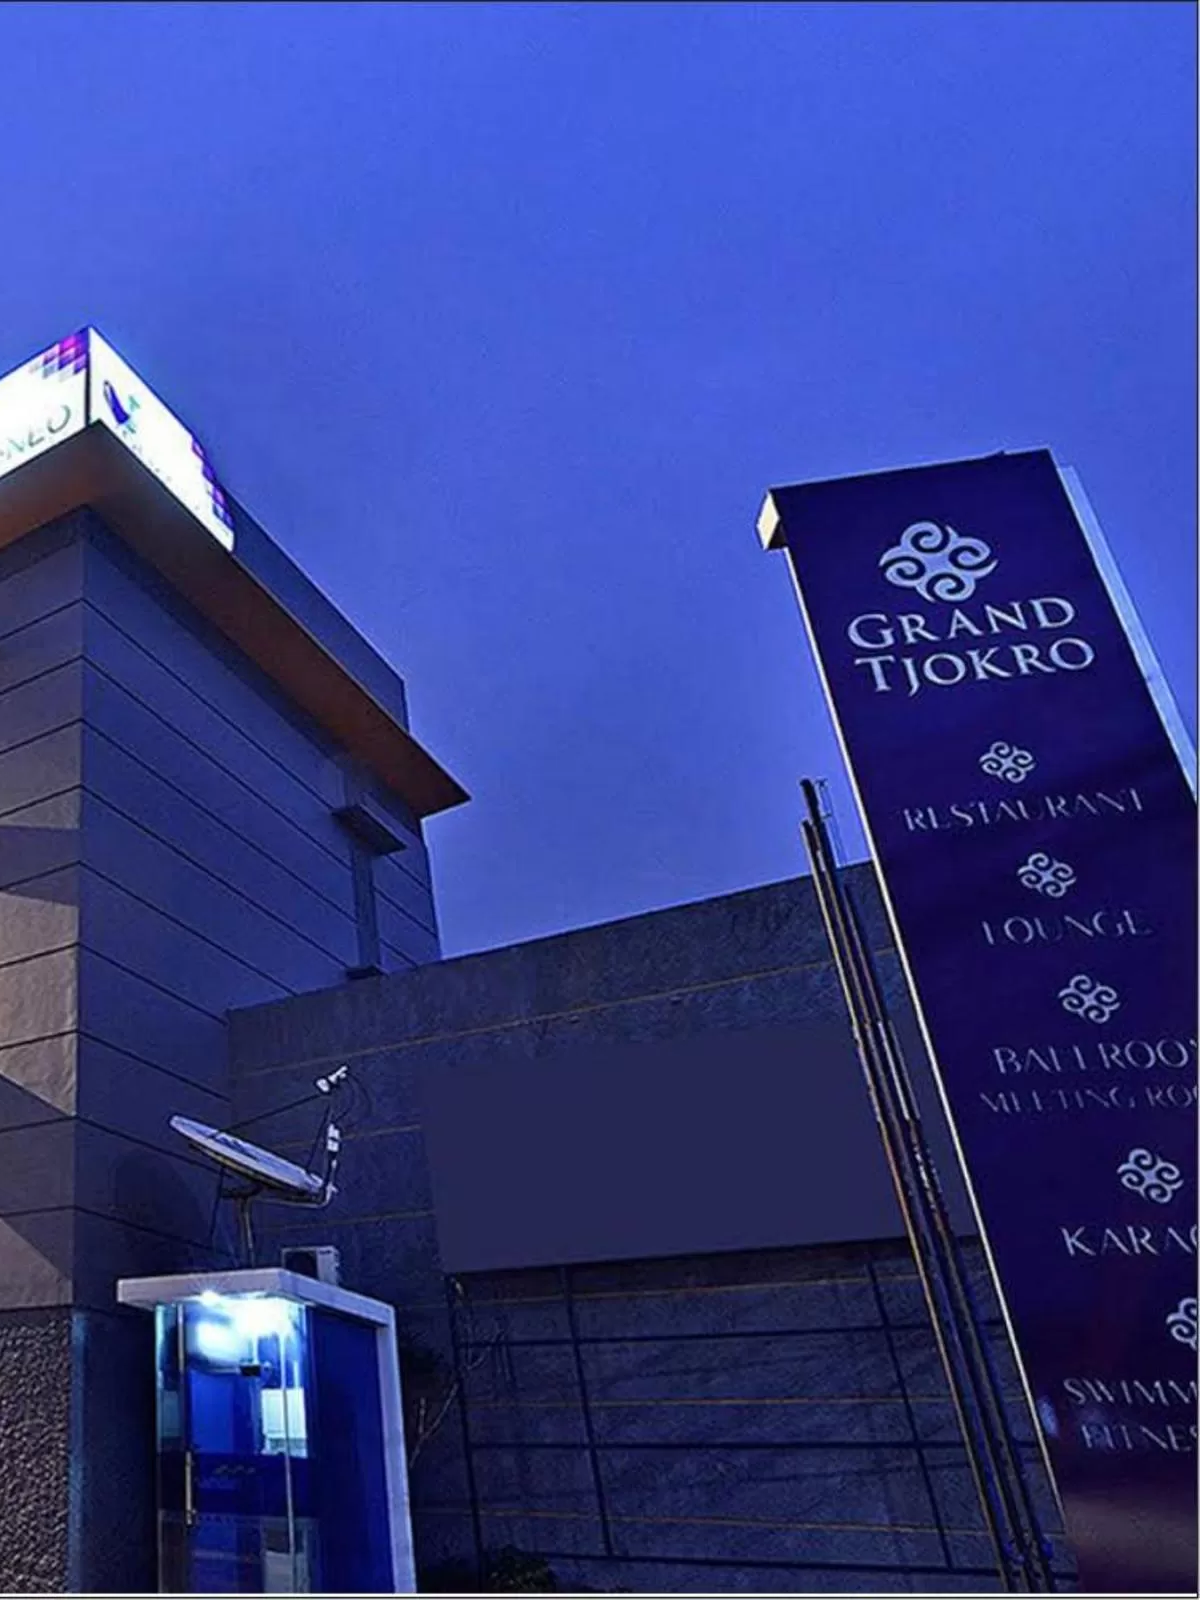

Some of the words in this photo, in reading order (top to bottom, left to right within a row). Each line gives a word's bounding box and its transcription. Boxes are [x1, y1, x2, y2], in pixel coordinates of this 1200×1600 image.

[847, 596, 1076, 650] GRAND
[853, 637, 1096, 697] TJOKRO
[902, 786, 1145, 832] RESTAURANT
[981, 908, 1153, 947] LOUNGE
[992, 1037, 1198, 1075] BALLROO
